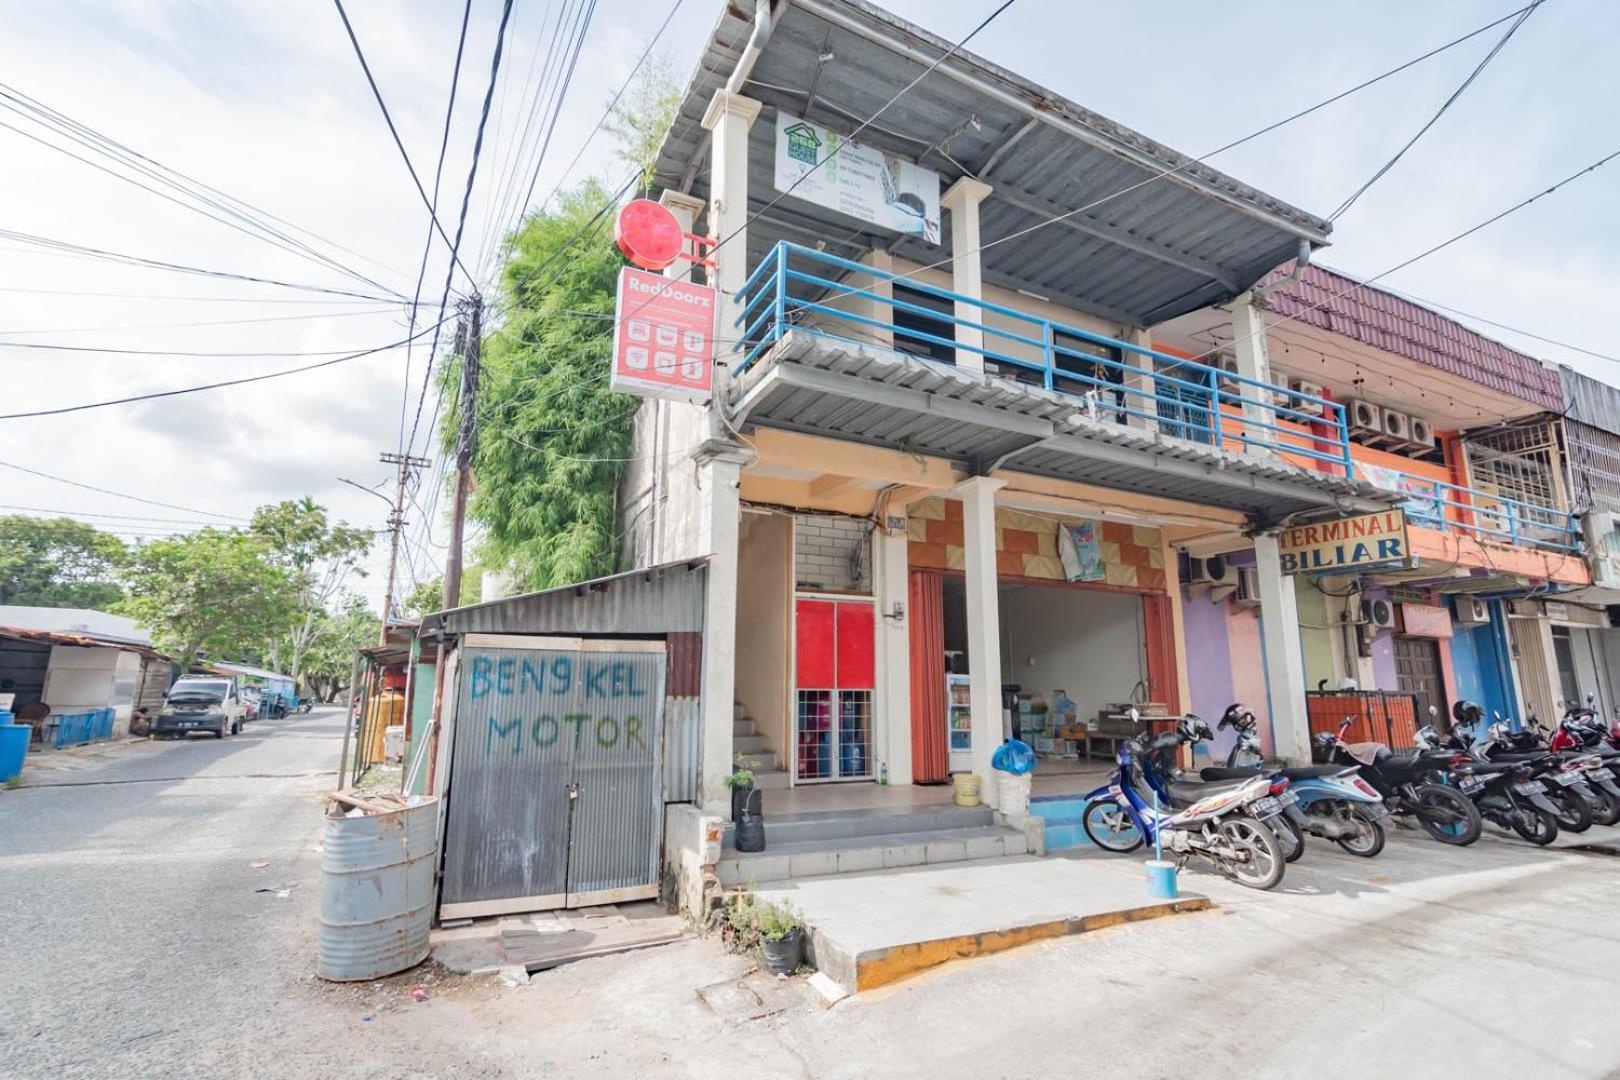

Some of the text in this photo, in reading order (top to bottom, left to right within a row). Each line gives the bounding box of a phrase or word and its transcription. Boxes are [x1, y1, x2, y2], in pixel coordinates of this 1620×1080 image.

[628, 276, 711, 308] RedDoorz
[1280, 512, 1402, 549] TERMINAL
[1280, 538, 1403, 571] BILIAR
[486, 714, 647, 757] MOTOR
